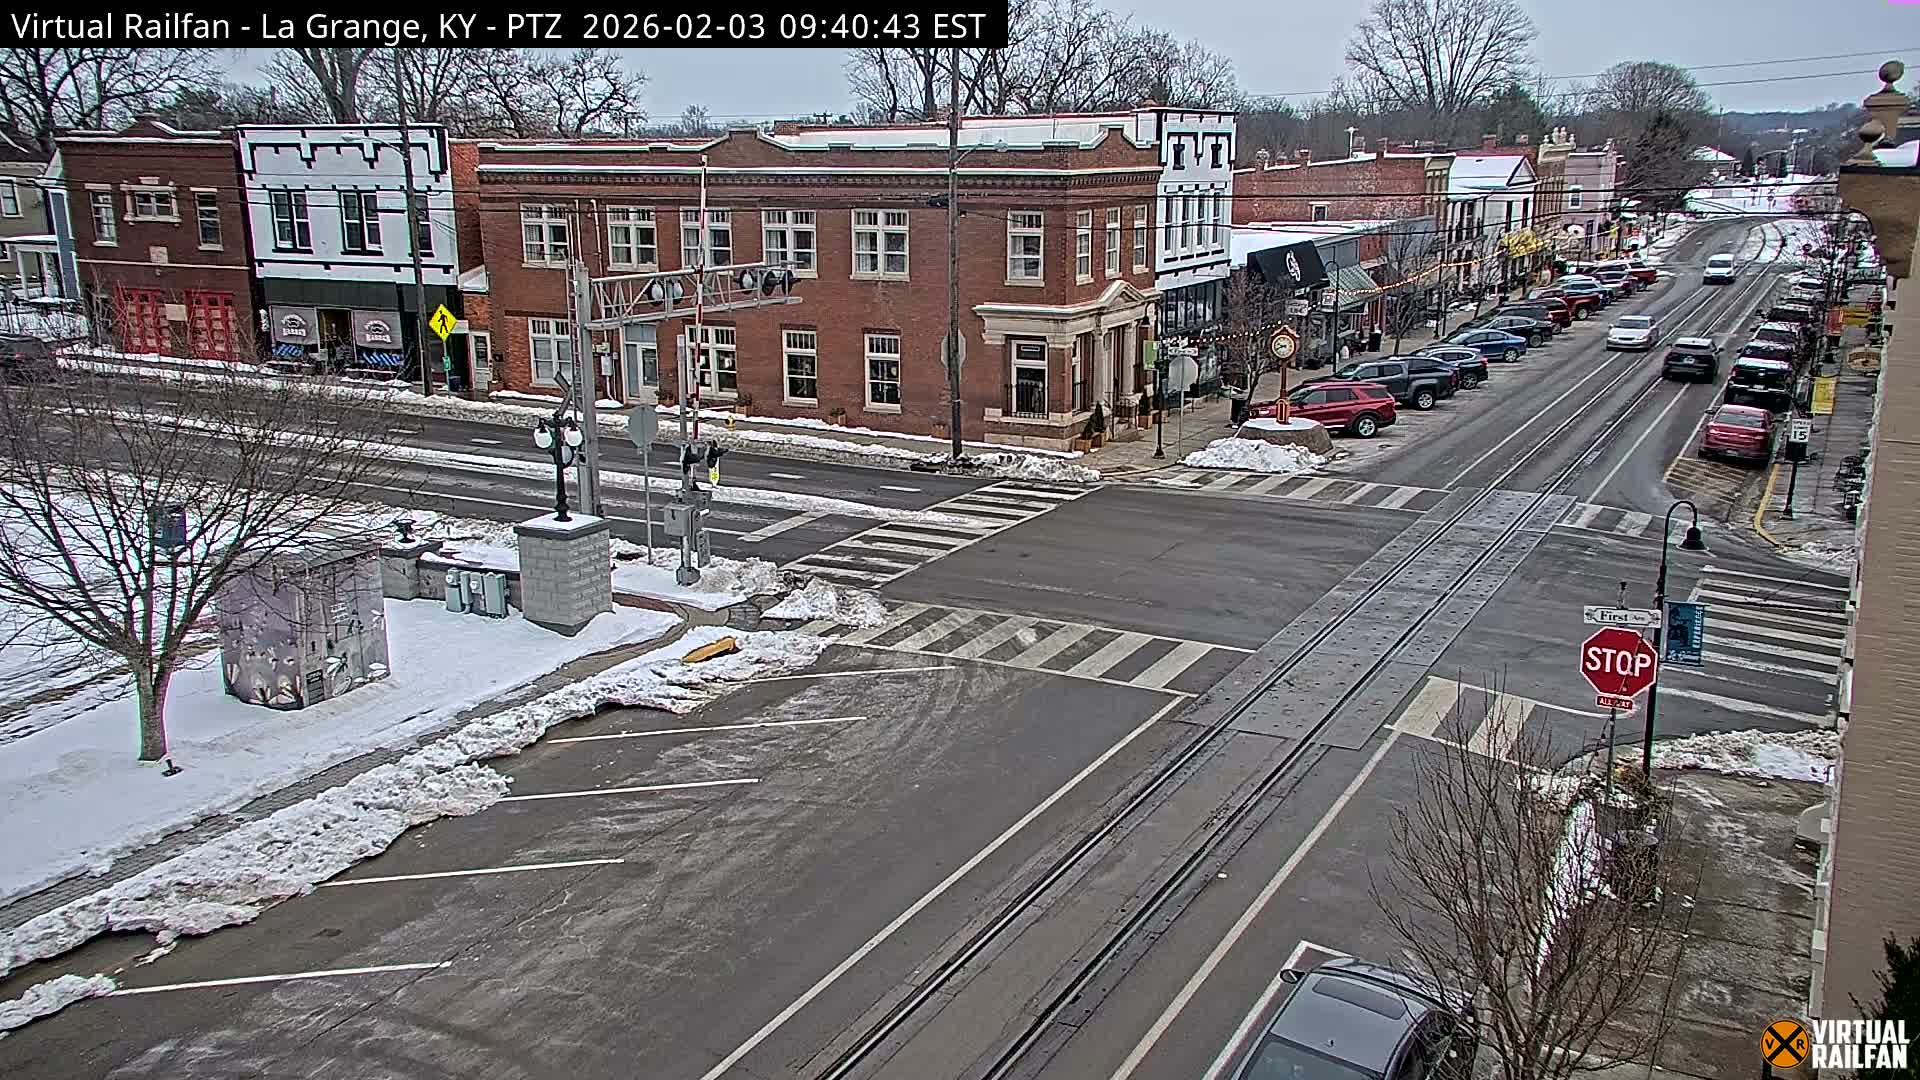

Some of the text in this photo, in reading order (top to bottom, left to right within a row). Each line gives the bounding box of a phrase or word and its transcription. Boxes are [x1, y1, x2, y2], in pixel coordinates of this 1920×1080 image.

[1793, 430, 1807, 441] 15
[1600, 610, 1628, 622] First
[1585, 646, 1652, 677] STOP
